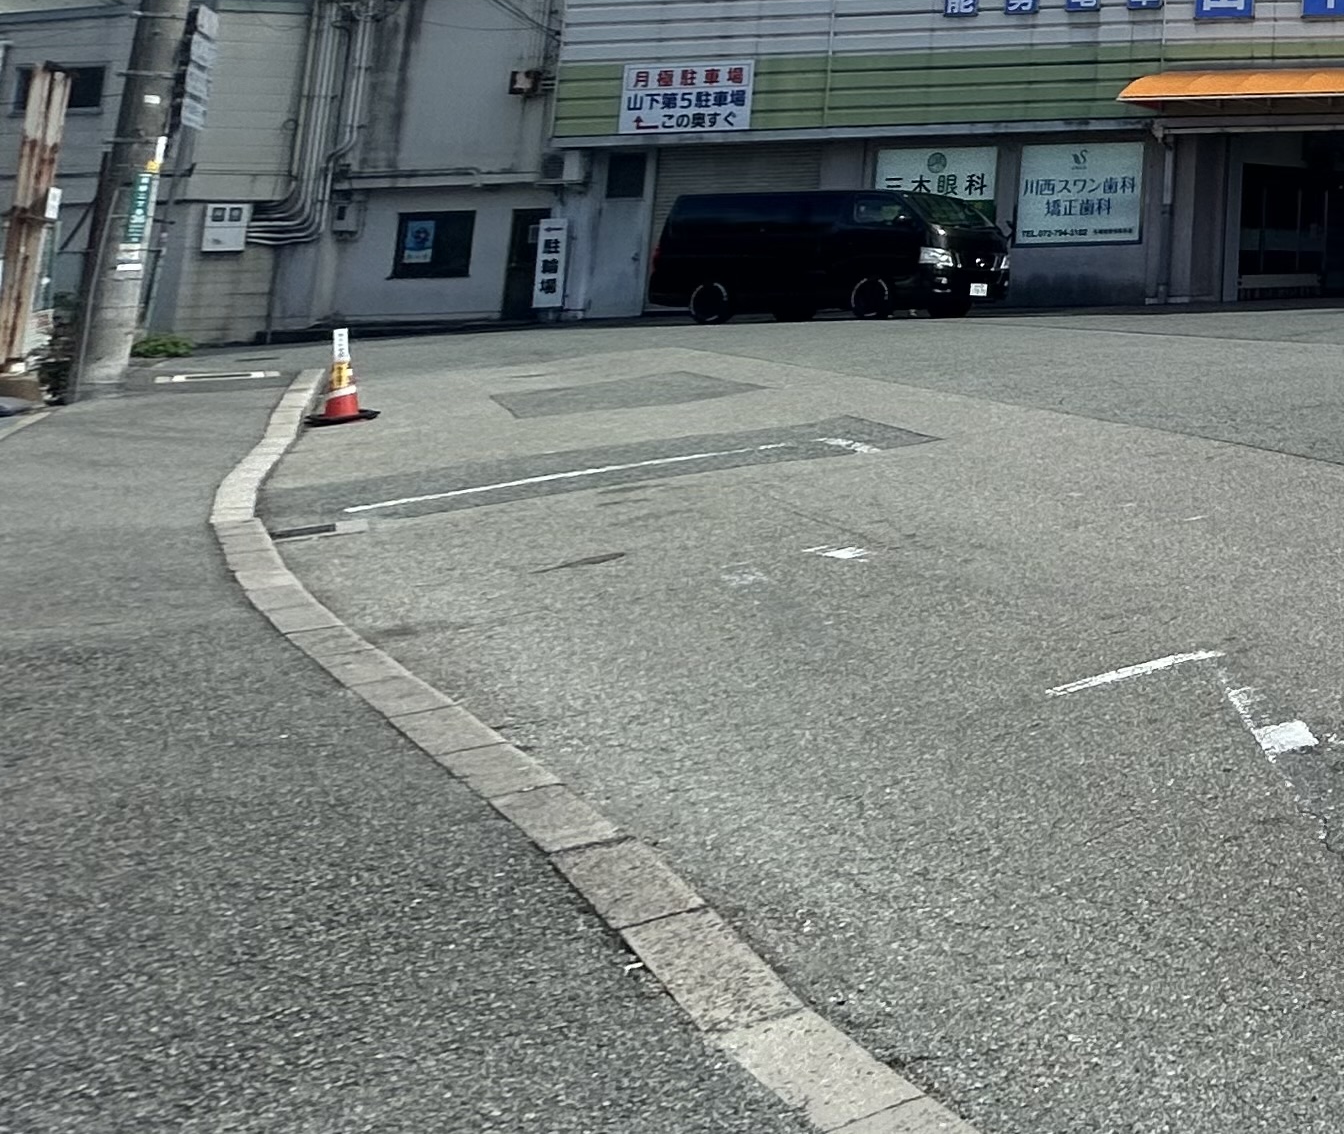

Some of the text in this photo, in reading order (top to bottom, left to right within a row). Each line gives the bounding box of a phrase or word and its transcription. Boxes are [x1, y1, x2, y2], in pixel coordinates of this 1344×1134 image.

[633, 67, 744, 88] 月極駐車場
[627, 89, 746, 111] 山下第5駐車場
[661, 111, 737, 129] この奥すぐ
[1023, 176, 1136, 196] 川西スワン歯科
[1045, 197, 1111, 216] 矯正歯科
[539, 238, 561, 295] 駐輪場
